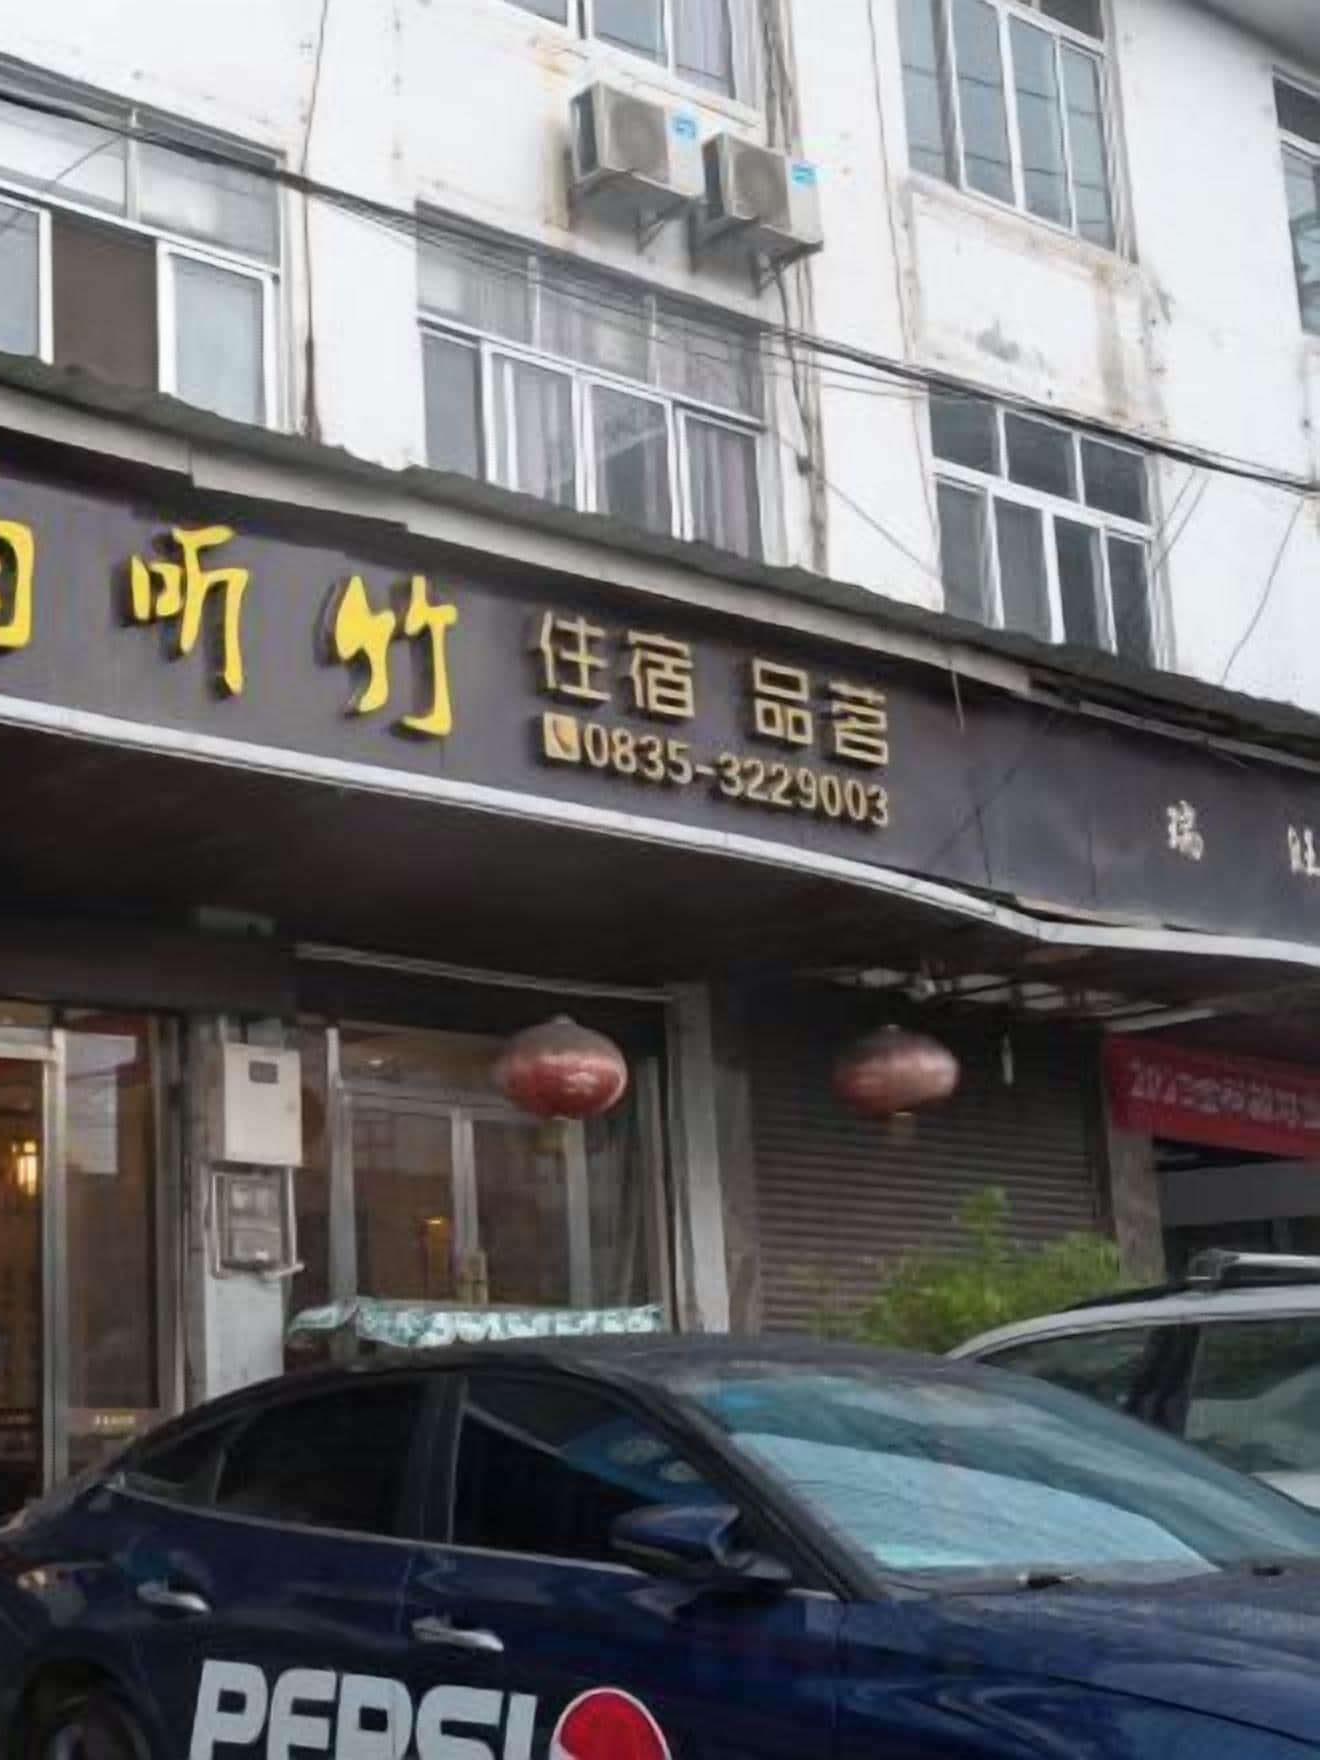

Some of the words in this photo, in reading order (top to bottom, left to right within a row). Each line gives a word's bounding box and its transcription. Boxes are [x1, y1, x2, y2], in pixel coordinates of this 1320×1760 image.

[539, 610, 695, 718] 住宿
[752, 657, 889, 766] 品茗
[583, 722, 889, 828] 0835-3229003
